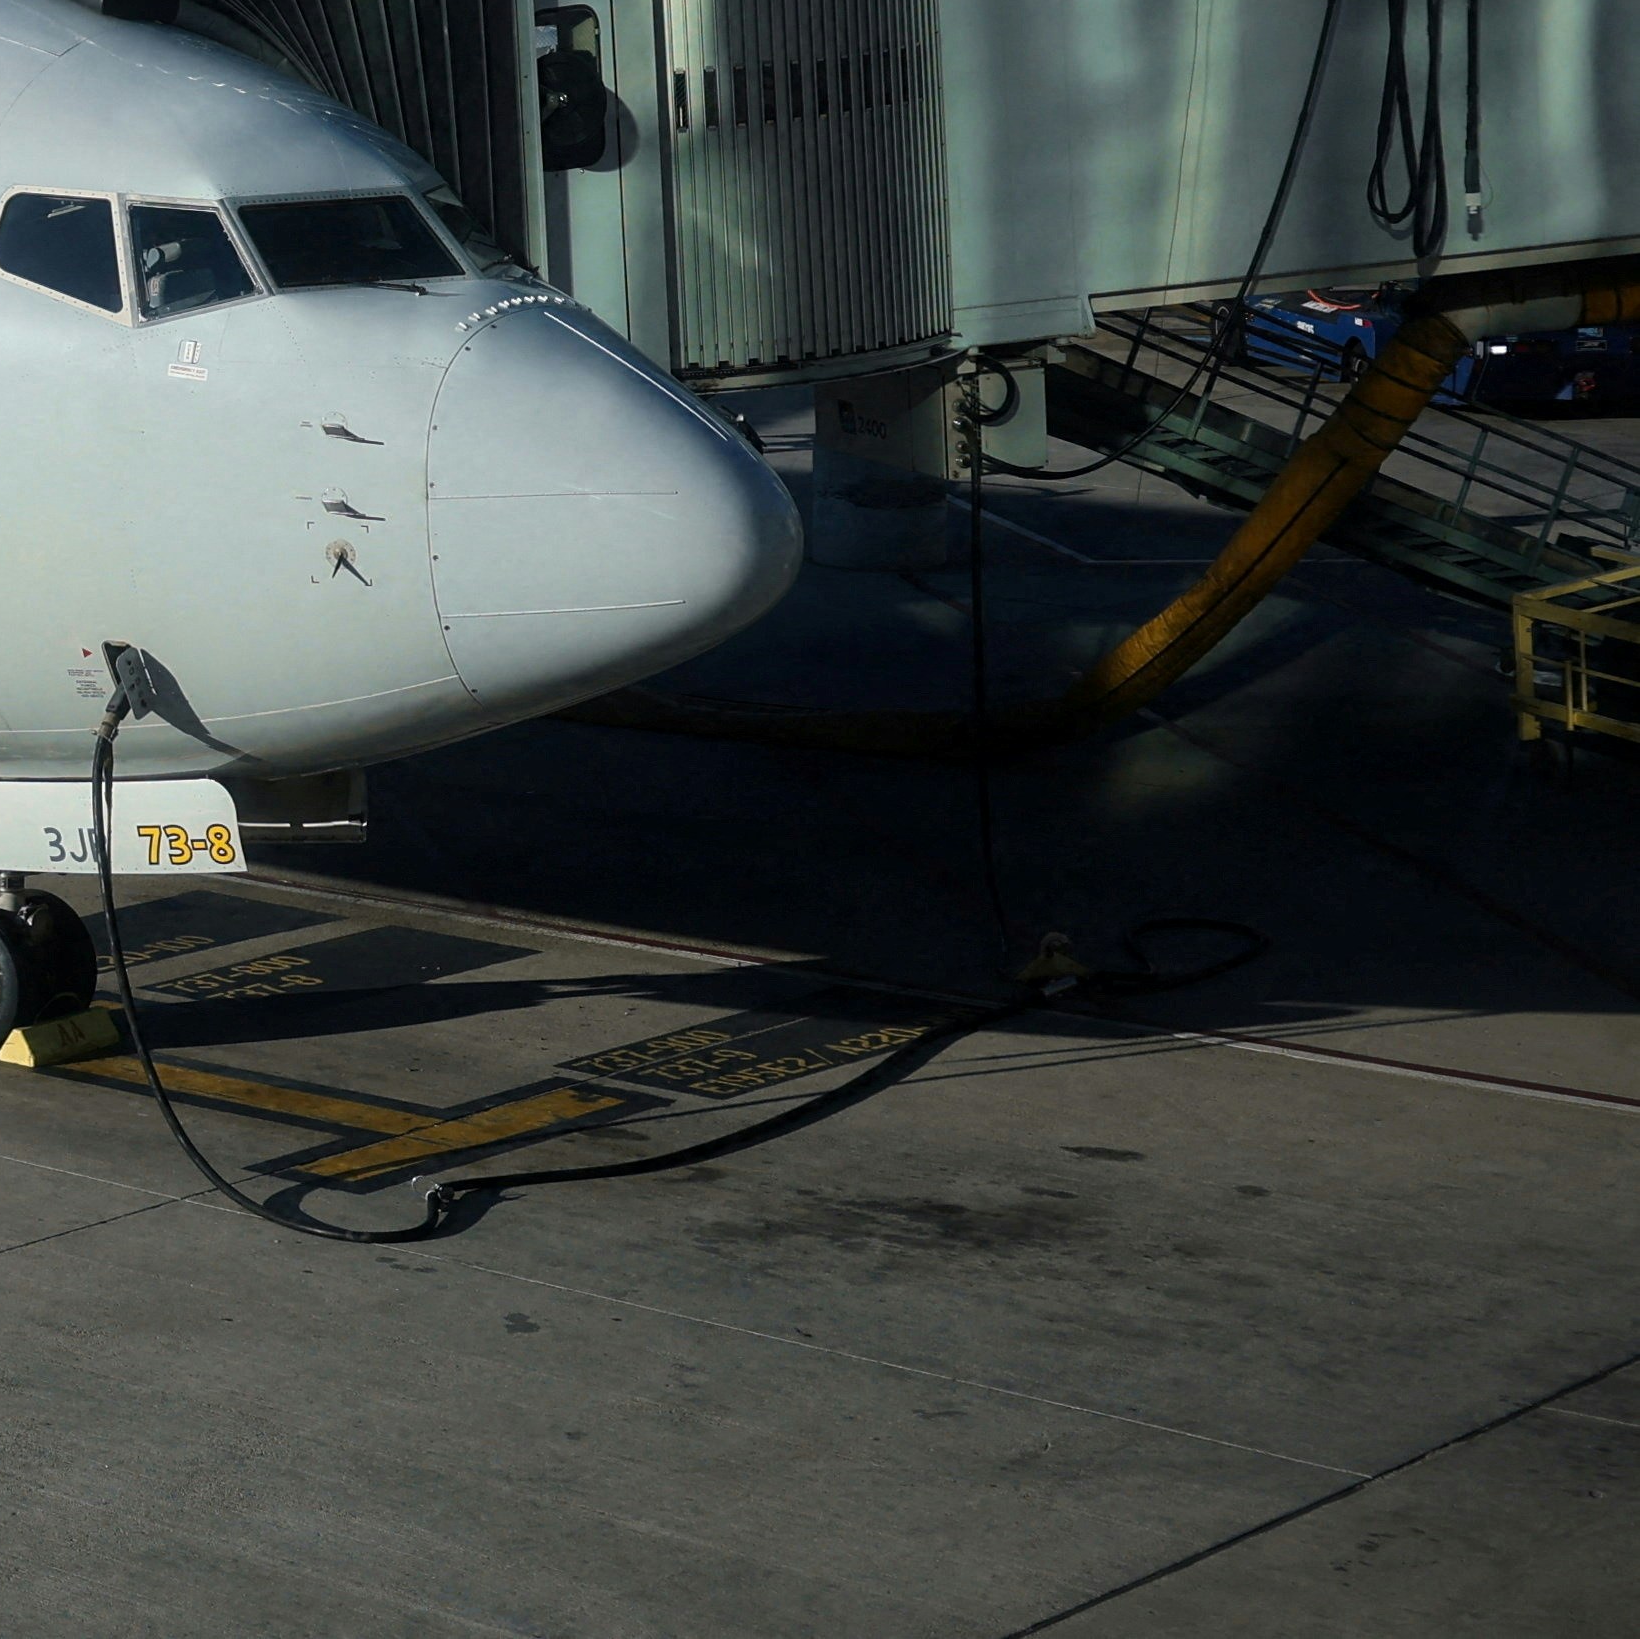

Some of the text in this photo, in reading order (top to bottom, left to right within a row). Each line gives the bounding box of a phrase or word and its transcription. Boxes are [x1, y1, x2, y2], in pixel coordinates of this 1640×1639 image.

[136, 823, 236, 865] 73-8
[156, 955, 312, 993] 737-800
[57, 1020, 86, 1047] AA
